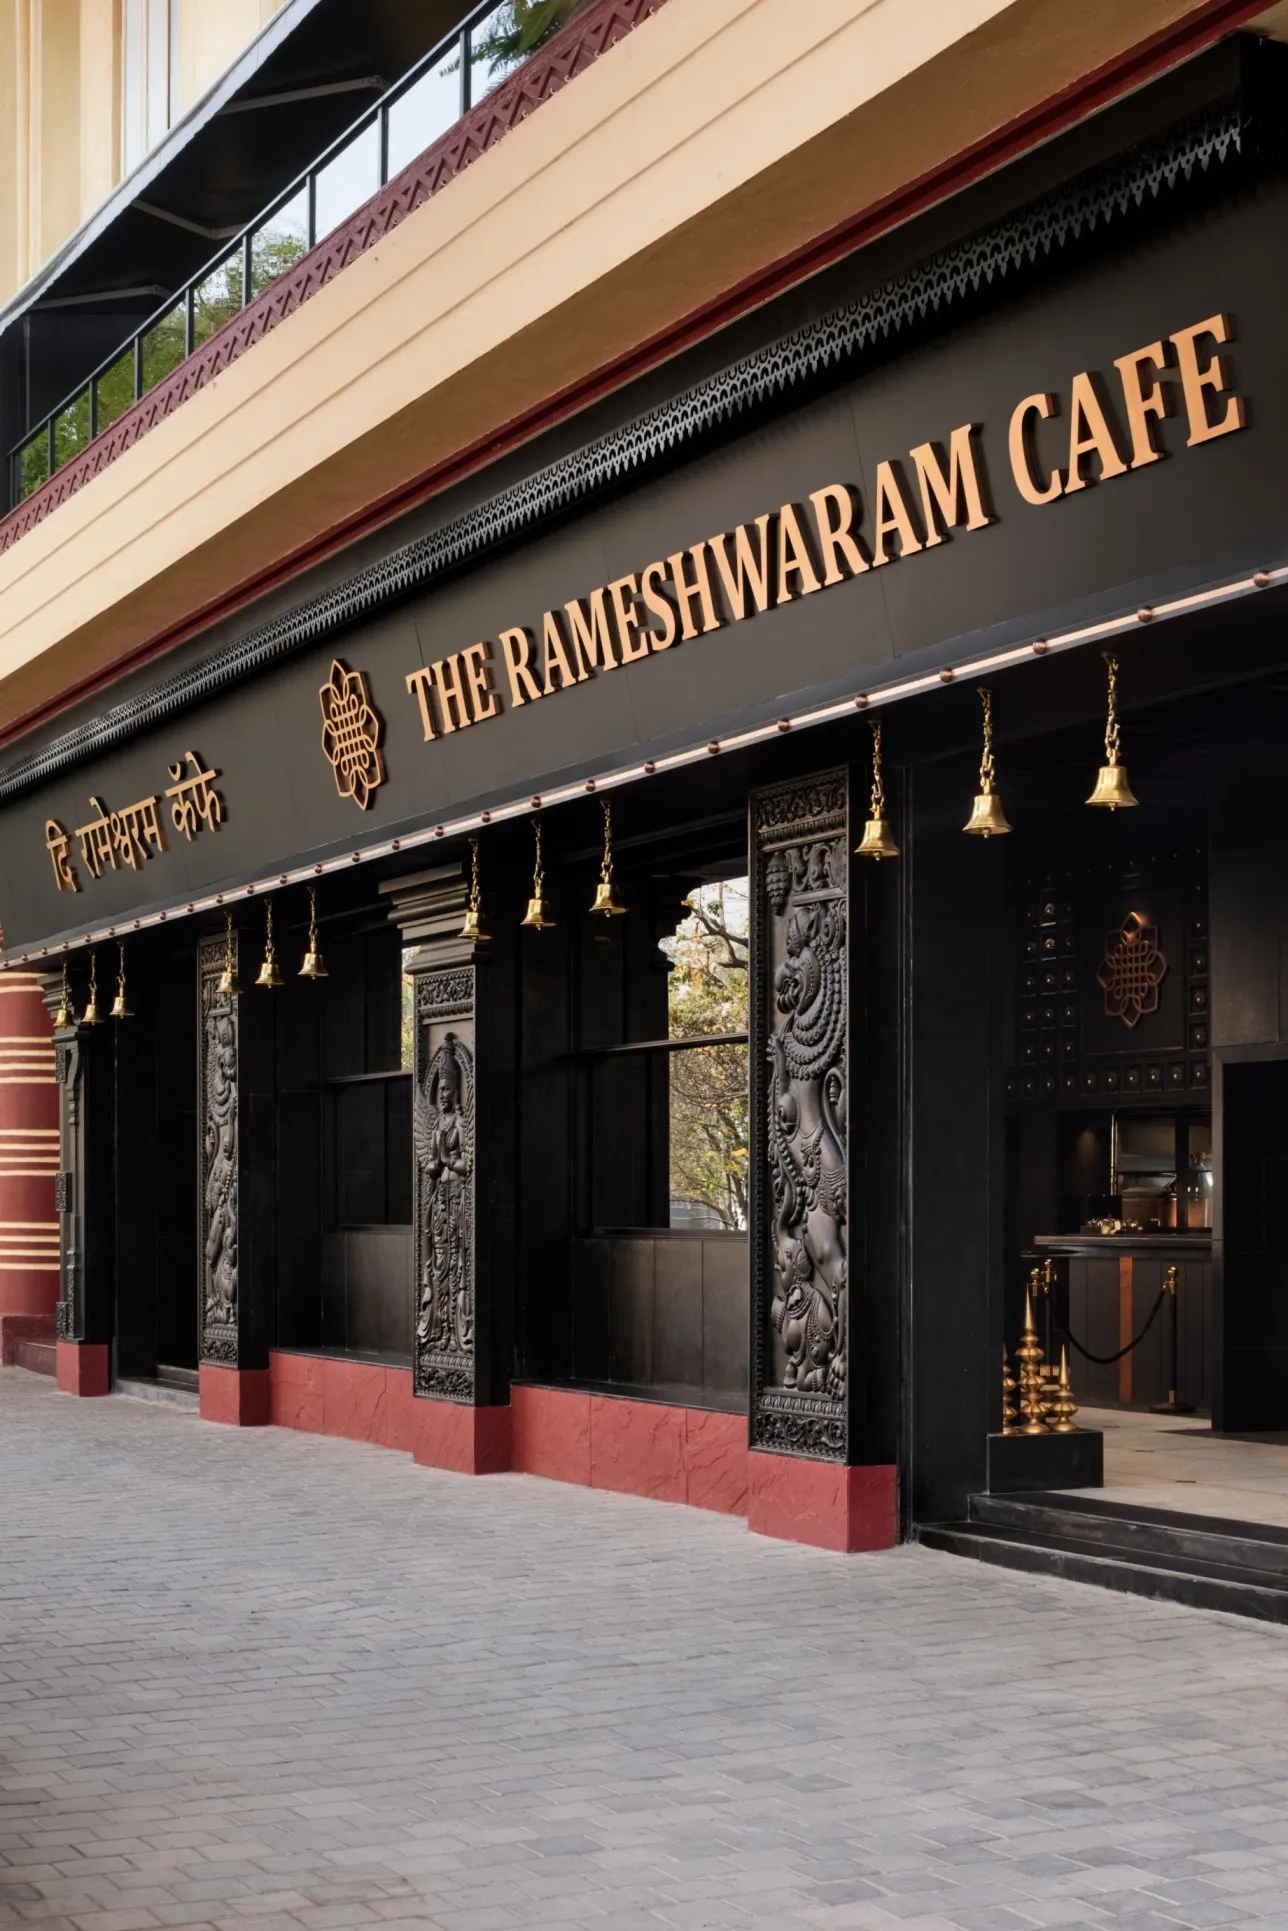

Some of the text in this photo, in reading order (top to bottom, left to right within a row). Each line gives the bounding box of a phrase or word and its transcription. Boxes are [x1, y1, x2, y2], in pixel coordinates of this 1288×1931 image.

[405, 313, 1247, 742] THE RAMESHWARAM CAFE
[45, 819, 79, 892] दि
[74, 796, 165, 879] रामेश्वरम
